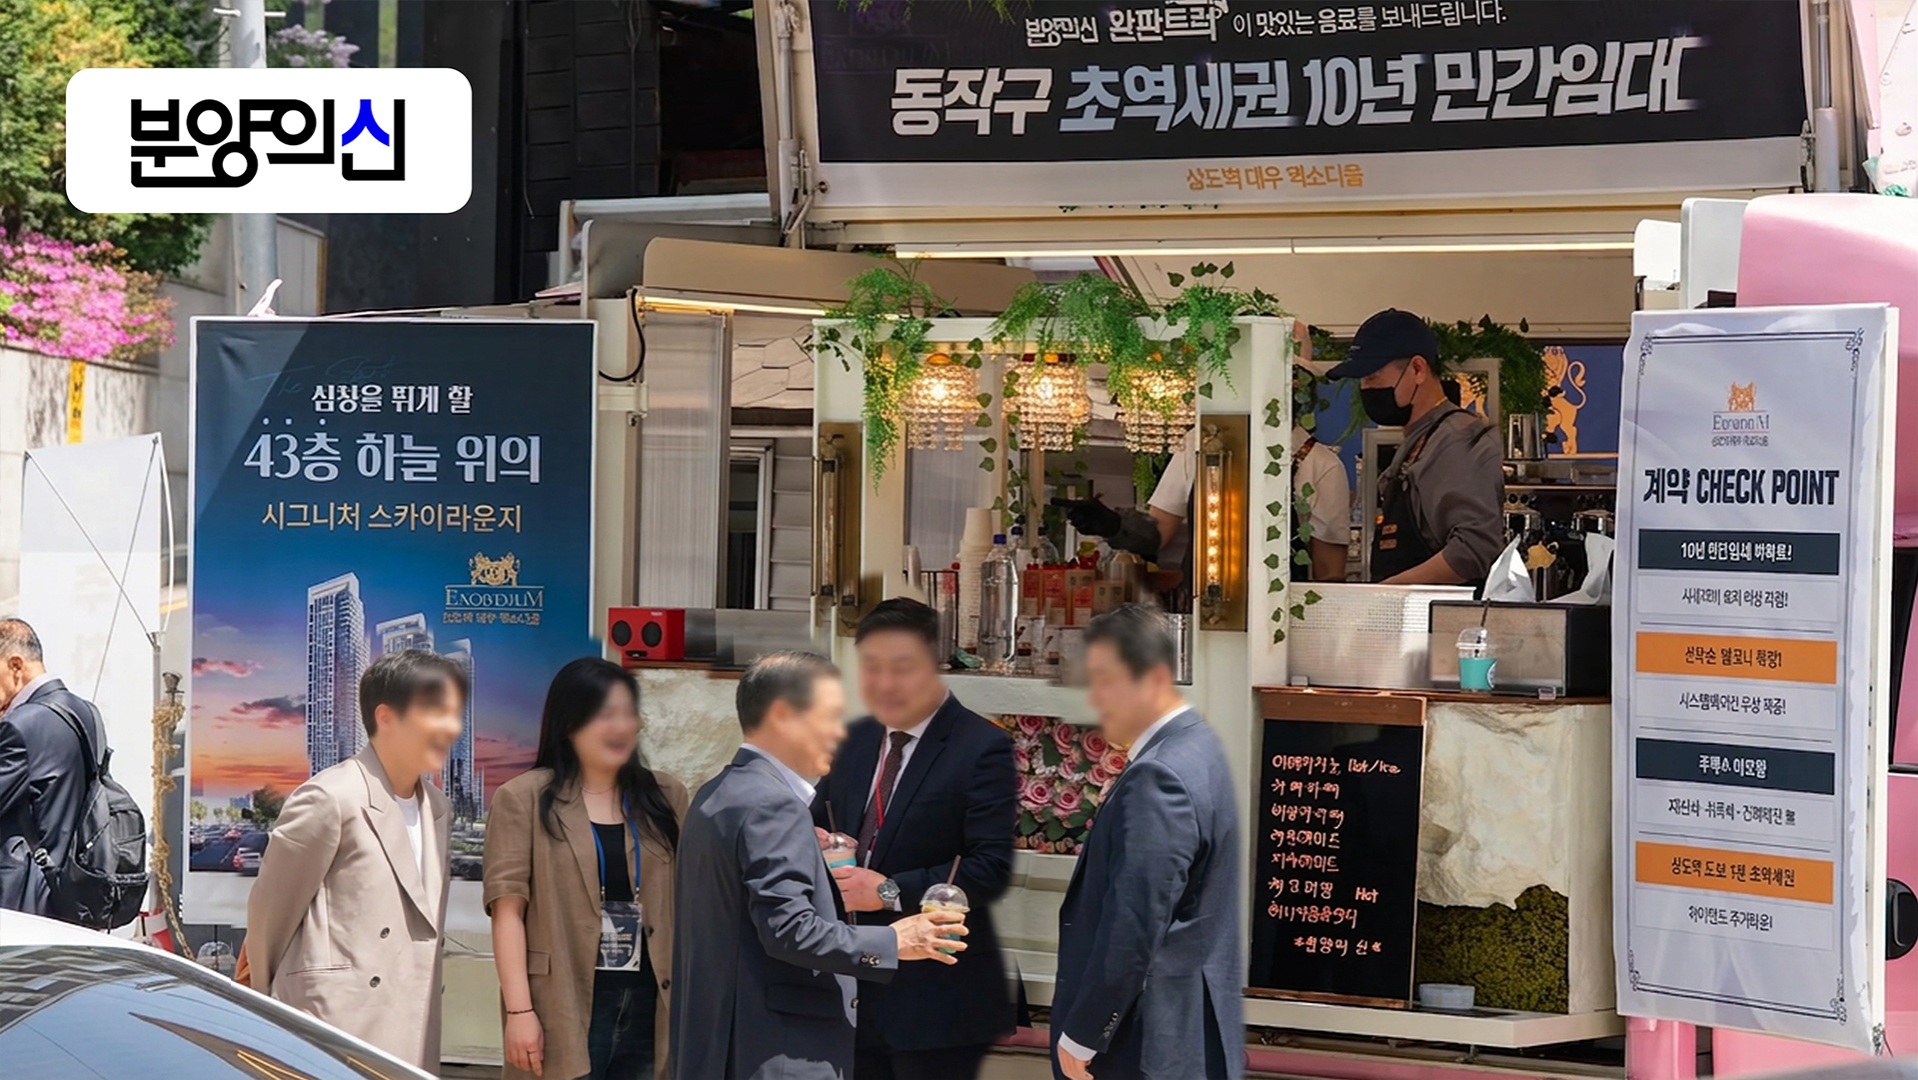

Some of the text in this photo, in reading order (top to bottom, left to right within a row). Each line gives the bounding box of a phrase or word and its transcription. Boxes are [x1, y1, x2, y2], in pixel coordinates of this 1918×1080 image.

[1233, 13, 1252, 37] 이
[1256, 10, 1314, 37] 맛있는
[1318, 6, 1377, 34] 음료를
[1381, 0, 1507, 28] 보내드립니다.
[891, 36, 1703, 136] 동작구 초역세권 10년 민간임대
[1245, 165, 1283, 190] 대우
[391, 384, 439, 413] 뛰게
[448, 385, 473, 414] 할
[244, 432, 541, 483] 43층 하늘 위의
[1643, 468, 1839, 506] 계약 CHECK POINT
[261, 502, 522, 533] 시그니처 스카이라운지
